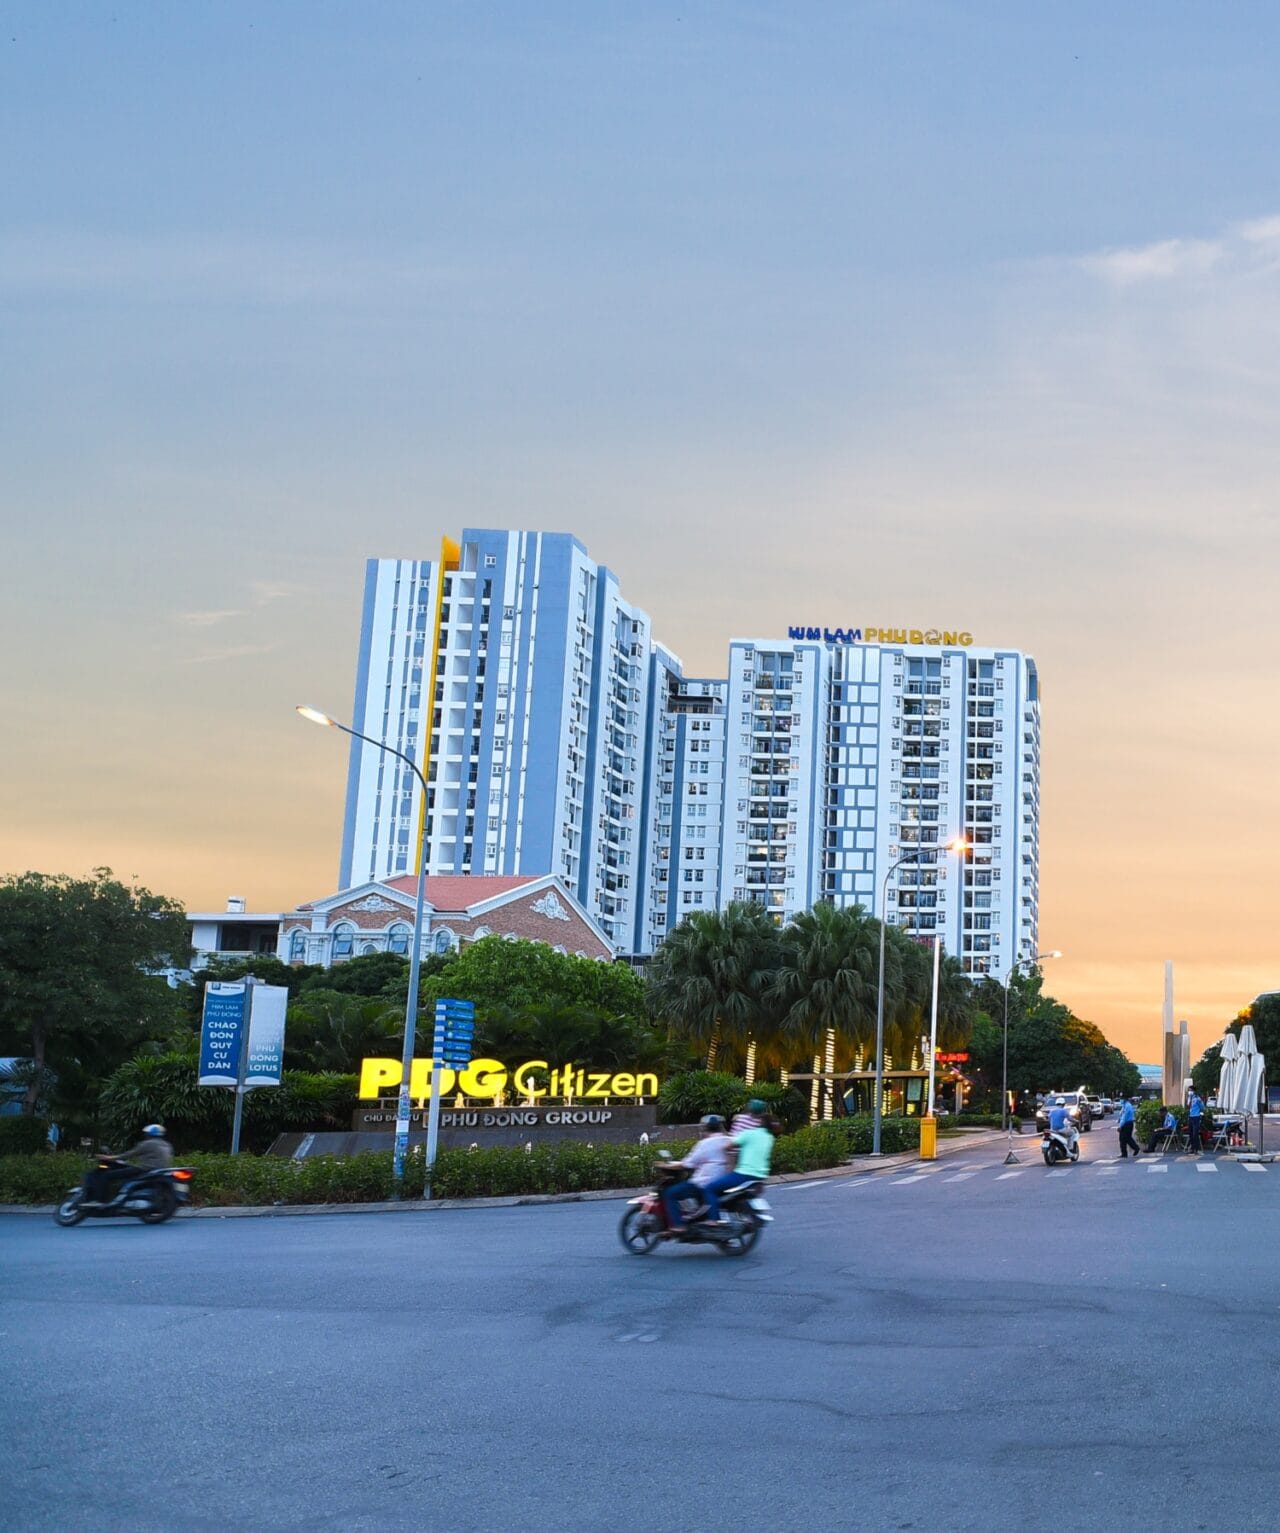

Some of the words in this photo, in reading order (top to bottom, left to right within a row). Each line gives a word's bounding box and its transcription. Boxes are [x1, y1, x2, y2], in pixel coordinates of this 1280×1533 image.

[824, 628, 862, 642] LAM
[249, 1064, 278, 1072] LOTUS
[359, 1058, 508, 1099] PDG
[514, 1060, 658, 1097] Citizen
[441, 1109, 478, 1127] PHÚ
[545, 1111, 612, 1125] GROUP
